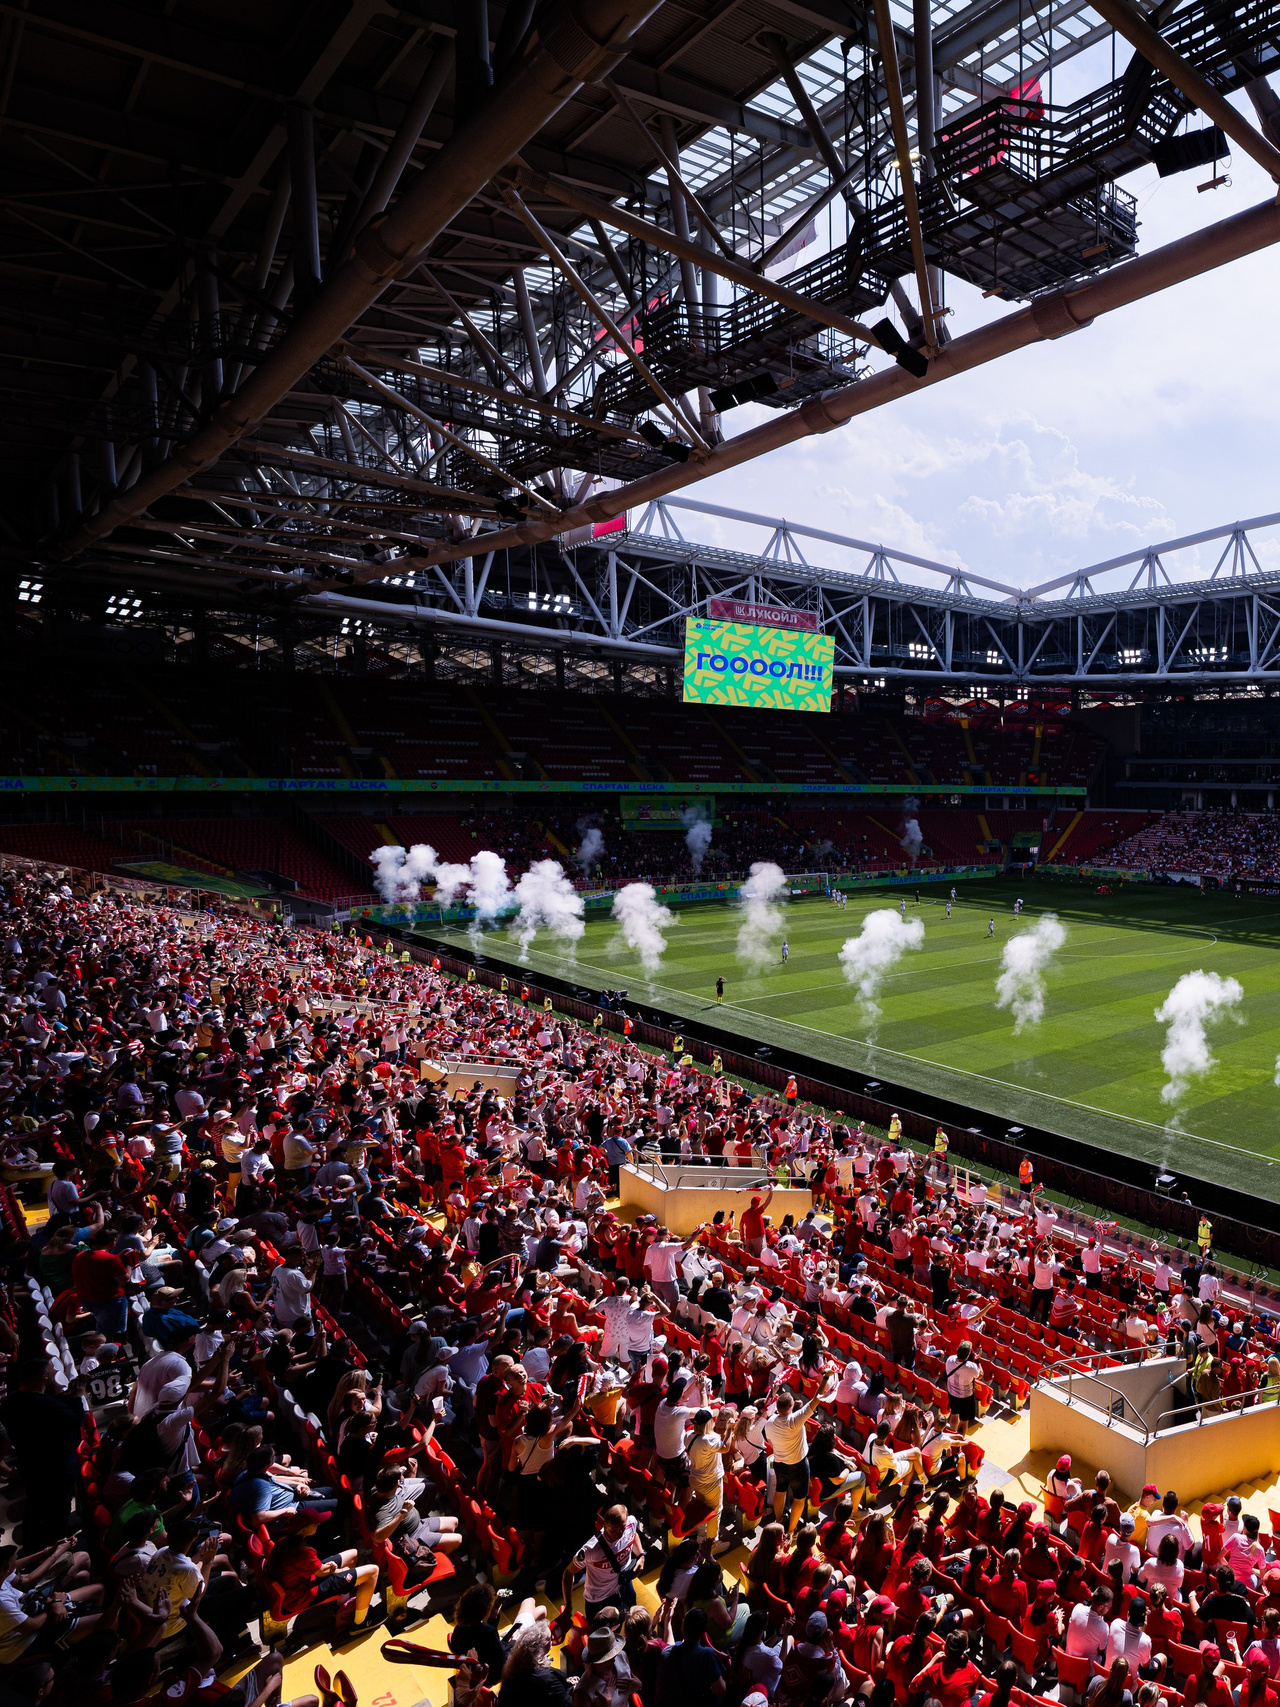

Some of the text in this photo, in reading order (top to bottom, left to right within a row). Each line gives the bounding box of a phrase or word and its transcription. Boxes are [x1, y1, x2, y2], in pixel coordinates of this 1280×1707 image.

[747, 607, 798, 624] ЛУКОЙЛ
[697, 652, 823, 682] ГООООЛ!!!
[268, 780, 336, 790] СПАРТАК
[349, 781, 388, 790] ЦСКА
[582, 783, 630, 791] СПАРТАК
[639, 783, 666, 791] ЦСКА
[888, 874, 946, 885] СПАРТАК ЦСКА
[680, 890, 726, 901] СПАРТАК
[90, 1375, 123, 1400] 98
